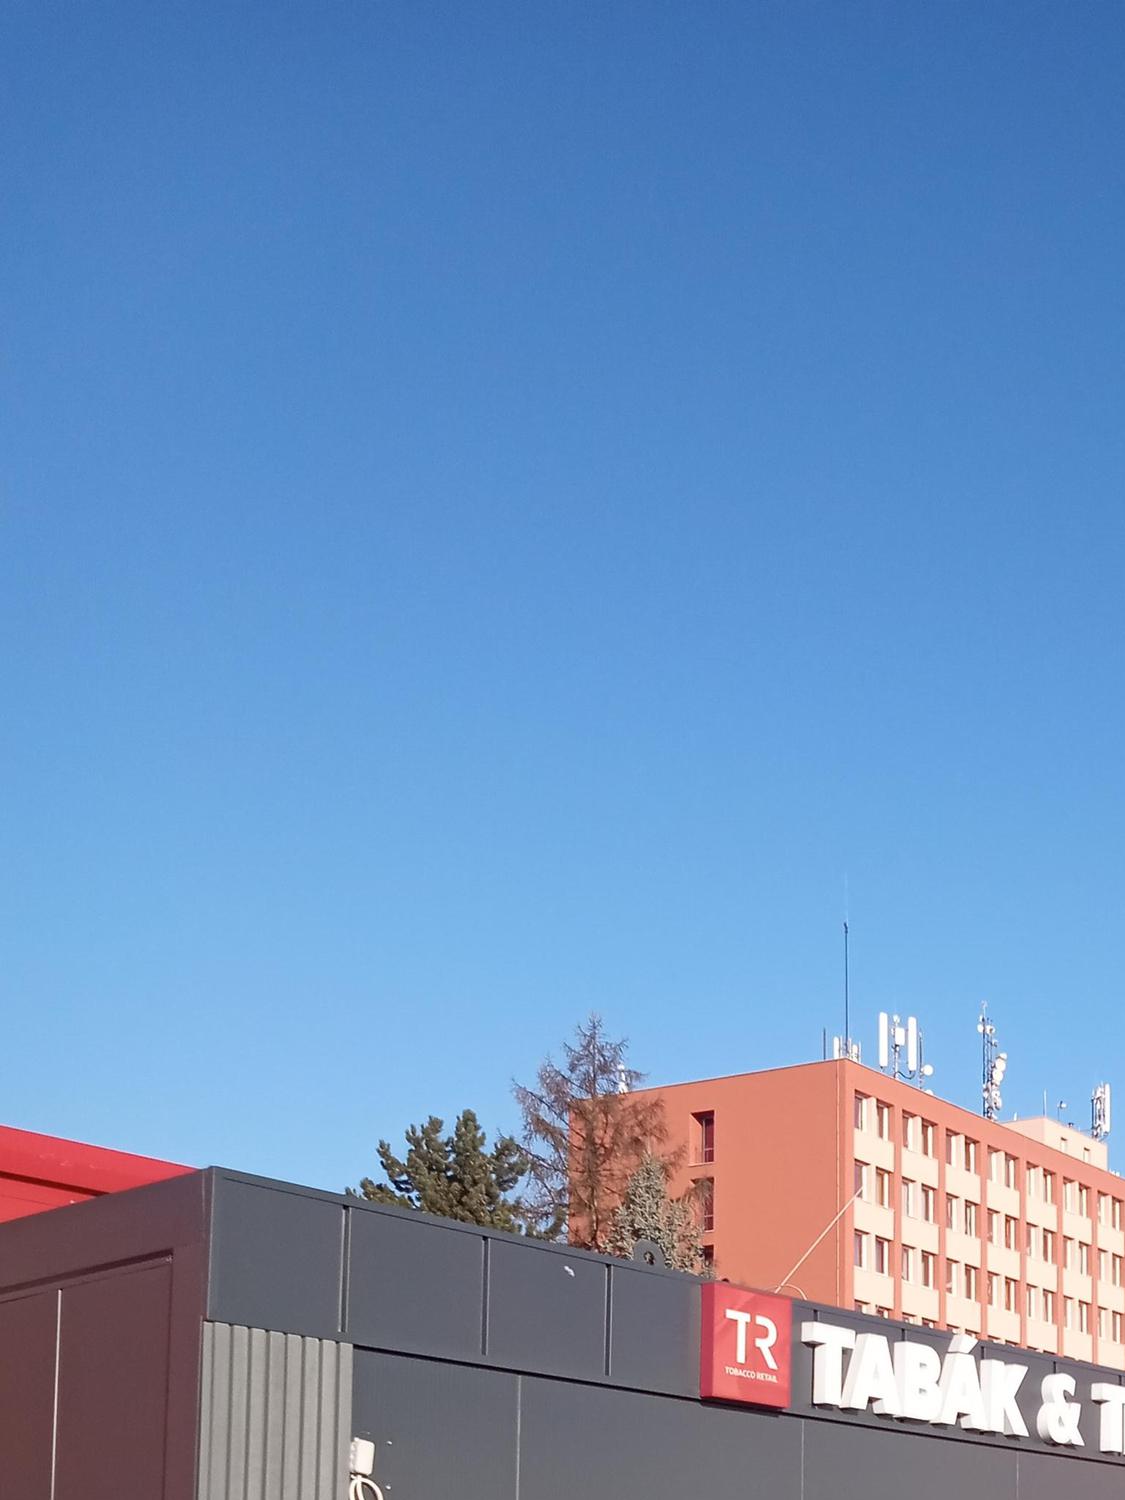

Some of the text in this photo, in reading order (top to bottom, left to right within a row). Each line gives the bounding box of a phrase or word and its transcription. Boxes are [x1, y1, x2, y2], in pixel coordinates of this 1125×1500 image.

[725, 1309, 778, 1370] TR
[725, 1366, 755, 1379] TOBACCO
[802, 1321, 1029, 1438] TABÁK
[1037, 1372, 1085, 1447] &
